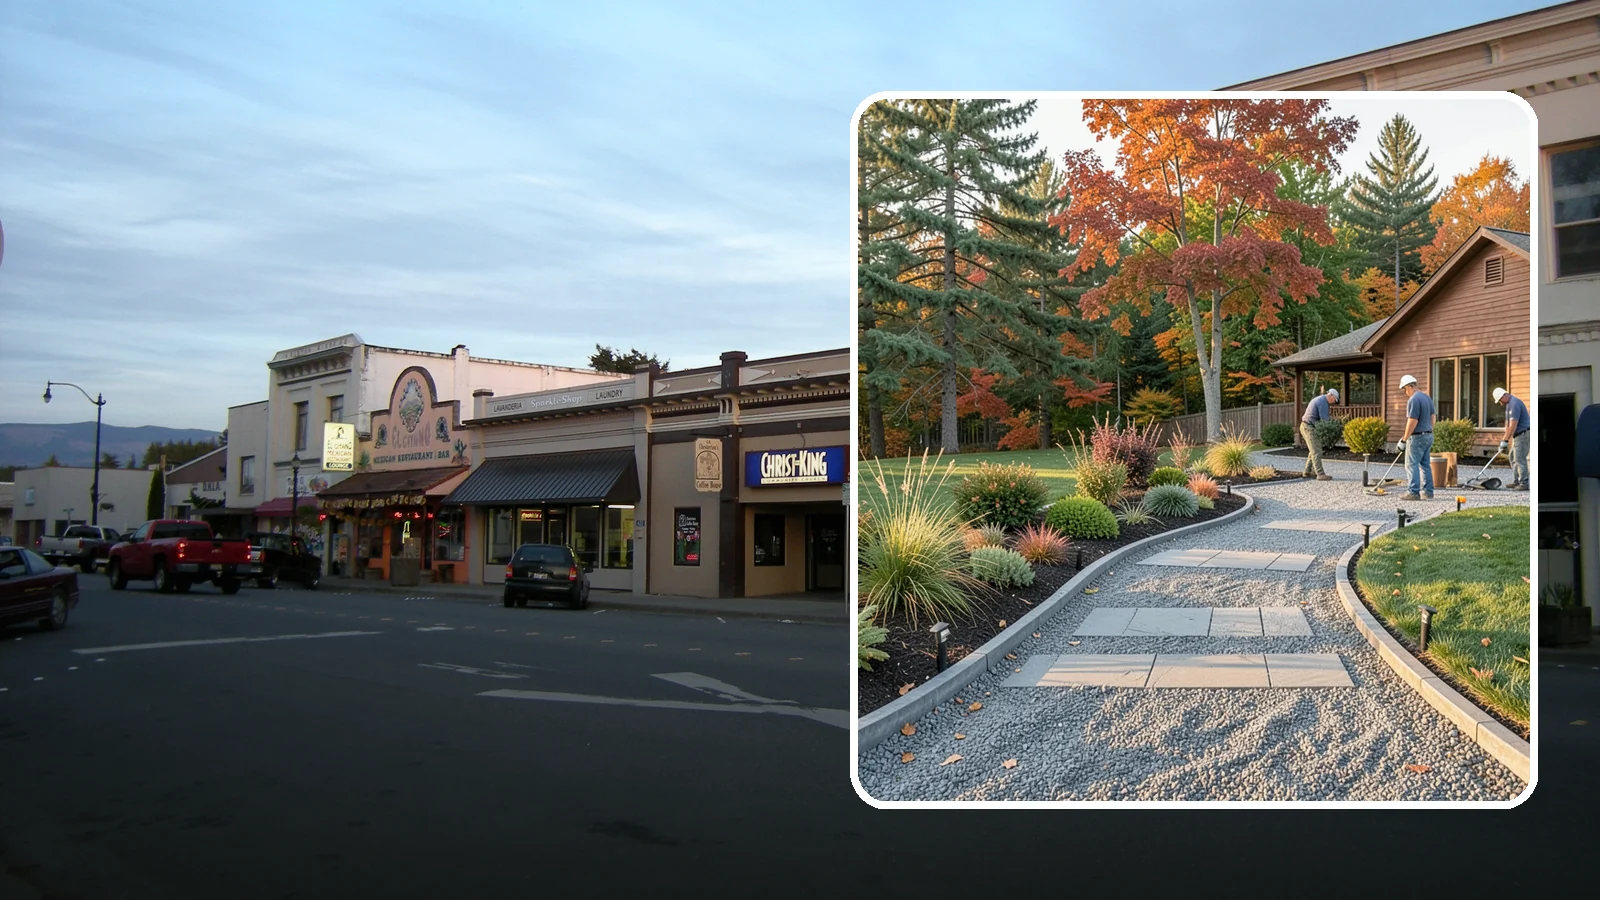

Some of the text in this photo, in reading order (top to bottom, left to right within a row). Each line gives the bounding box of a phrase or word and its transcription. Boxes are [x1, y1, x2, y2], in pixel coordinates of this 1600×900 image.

[595, 389, 624, 400] LAUNDRY
[493, 402, 522, 412] LAVANDERIA
[374, 454, 396, 464] MEXICAN
[397, 451, 433, 462] RESTAURANT
[437, 450, 450, 459] BAR
[761, 450, 827, 478] CHRIST KING
